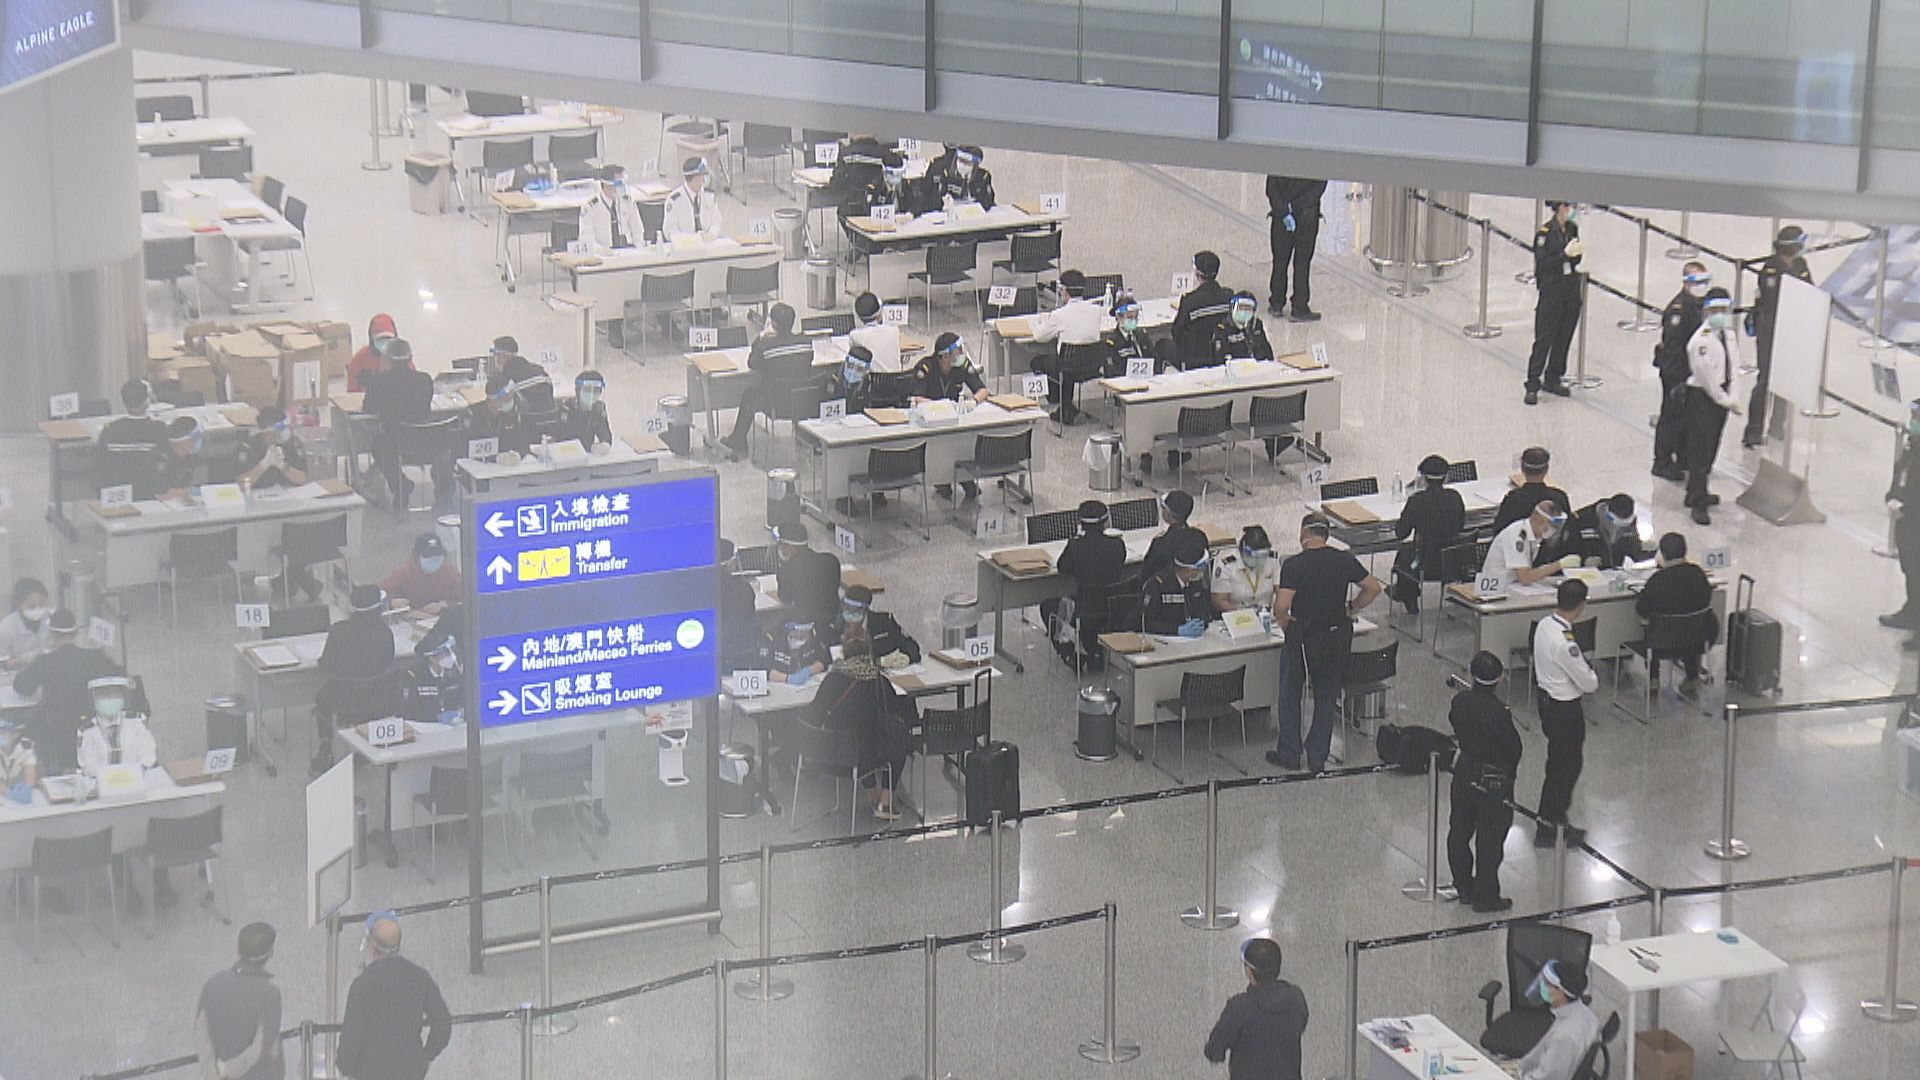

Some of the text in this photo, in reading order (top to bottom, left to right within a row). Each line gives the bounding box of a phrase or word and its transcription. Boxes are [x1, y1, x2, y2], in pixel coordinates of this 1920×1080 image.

[15, 10, 96, 55] ALPINE EAGLE
[820, 147, 834, 158] 47
[1045, 197, 1060, 209] 41
[876, 208, 890, 219] 42
[753, 223, 767, 234] 43
[1176, 276, 1188, 289] 31
[994, 288, 1010, 299] 32
[888, 309, 903, 321] 33
[695, 332, 711, 344] 34
[1132, 362, 1148, 374] 22
[1028, 381, 1044, 393] 23
[825, 405, 841, 417] 24
[475, 442, 492, 453] 26
[1307, 470, 1322, 484] 12
[551, 492, 630, 518] 入境檢查
[551, 512, 629, 533] Immigration
[983, 521, 997, 532] 14
[839, 534, 851, 549] 15
[575, 539, 612, 560] 轉機
[576, 556, 628, 575] Transfer
[1707, 553, 1724, 566] 01
[1480, 578, 1499, 591] 02
[243, 608, 262, 622] 18
[522, 640, 673, 671] Mainland/Macao Ferries
[970, 642, 989, 656] 05
[740, 677, 760, 690] 06
[555, 684, 662, 711] Smoking Lounge
[375, 724, 396, 739] 08
[209, 754, 229, 769] 09
